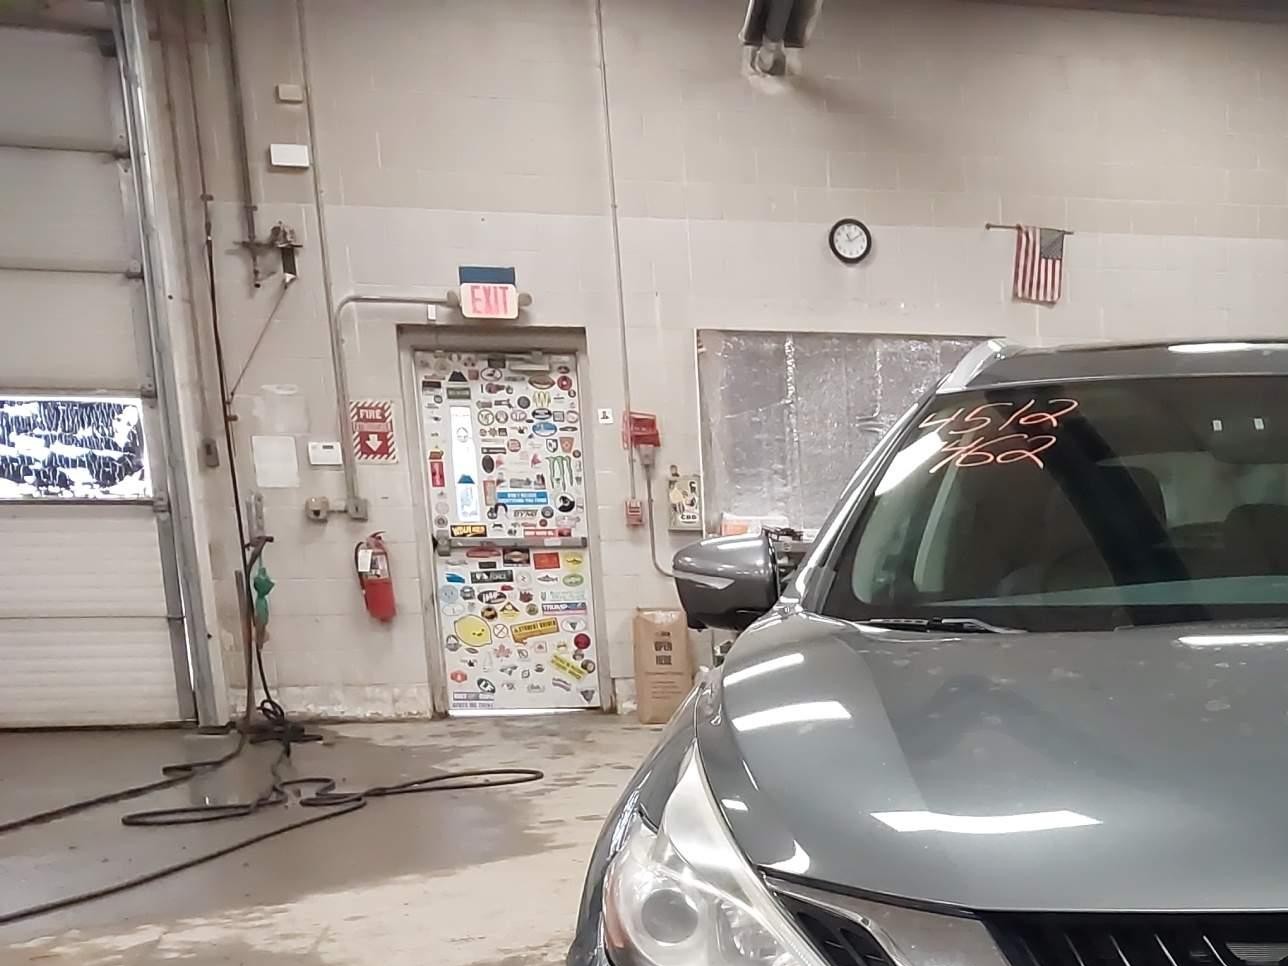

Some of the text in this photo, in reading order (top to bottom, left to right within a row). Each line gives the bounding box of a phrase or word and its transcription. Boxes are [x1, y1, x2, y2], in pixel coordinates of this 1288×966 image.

[471, 285, 508, 314] EXIT
[359, 408, 383, 420] FIRE
[918, 399, 1079, 435] 4512
